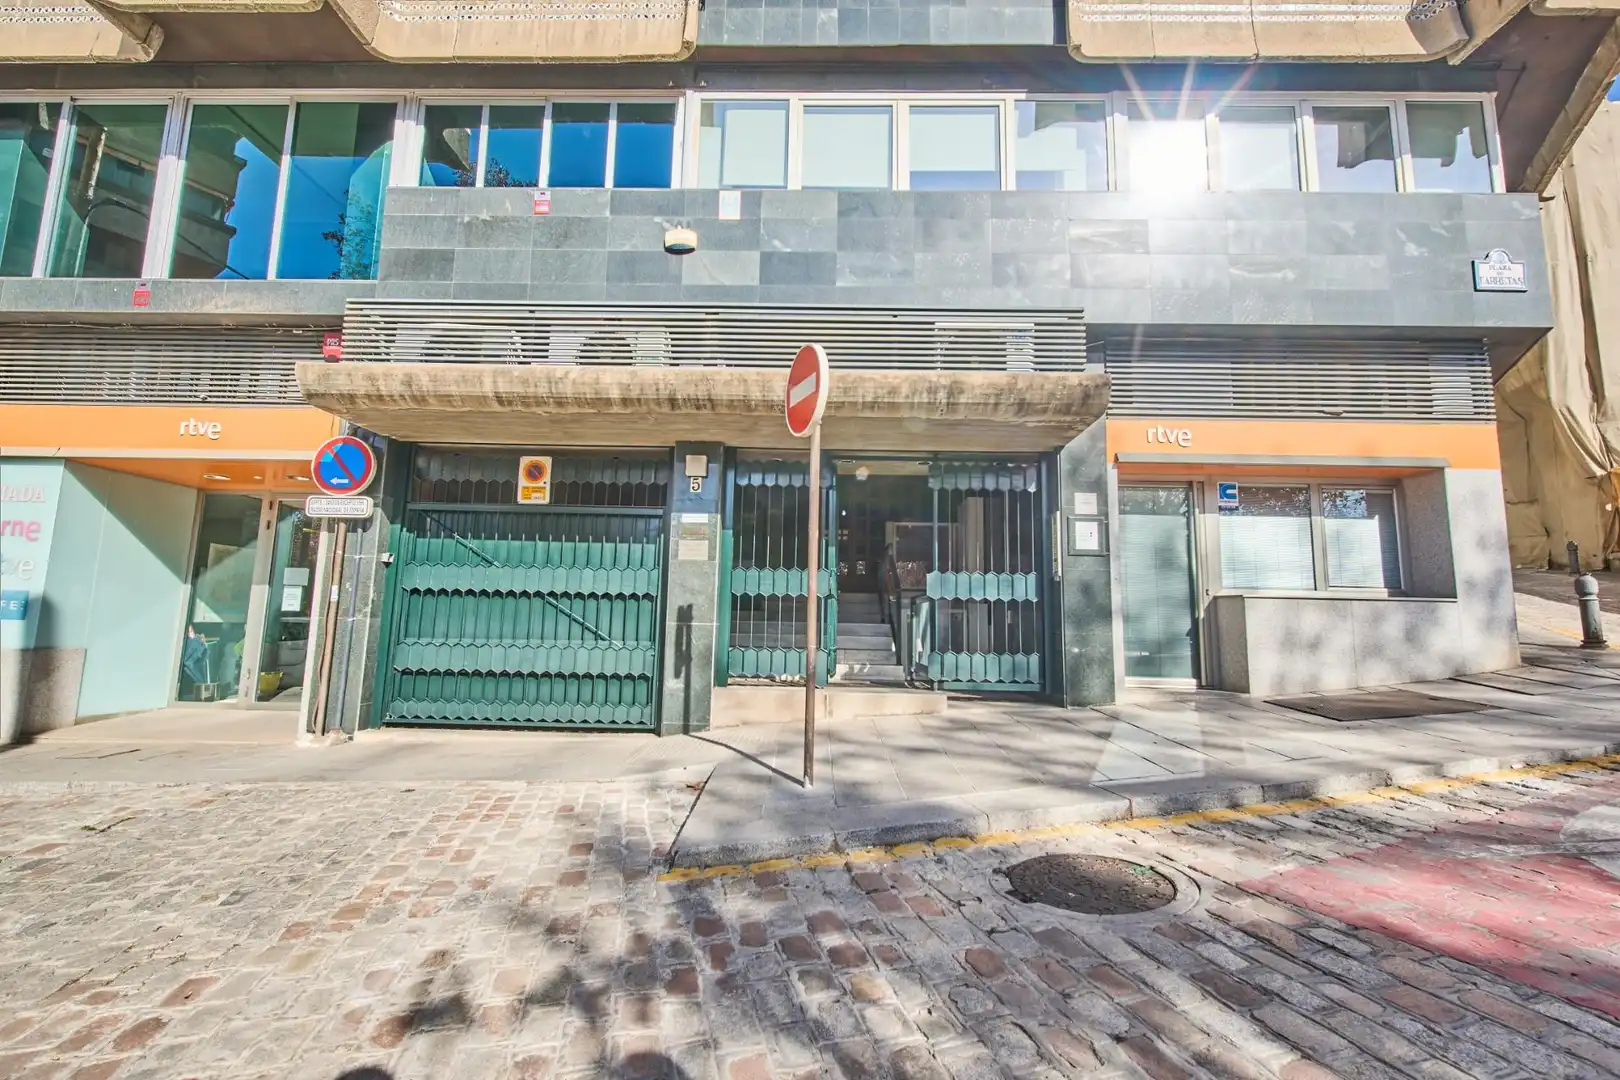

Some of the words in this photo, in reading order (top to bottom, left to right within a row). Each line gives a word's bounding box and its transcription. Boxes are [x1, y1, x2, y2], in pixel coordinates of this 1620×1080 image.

[179, 416, 221, 441] rtve
[1146, 425, 1193, 448] rtve
[691, 477, 701, 491] 5
[0, 519, 41, 542] rne
